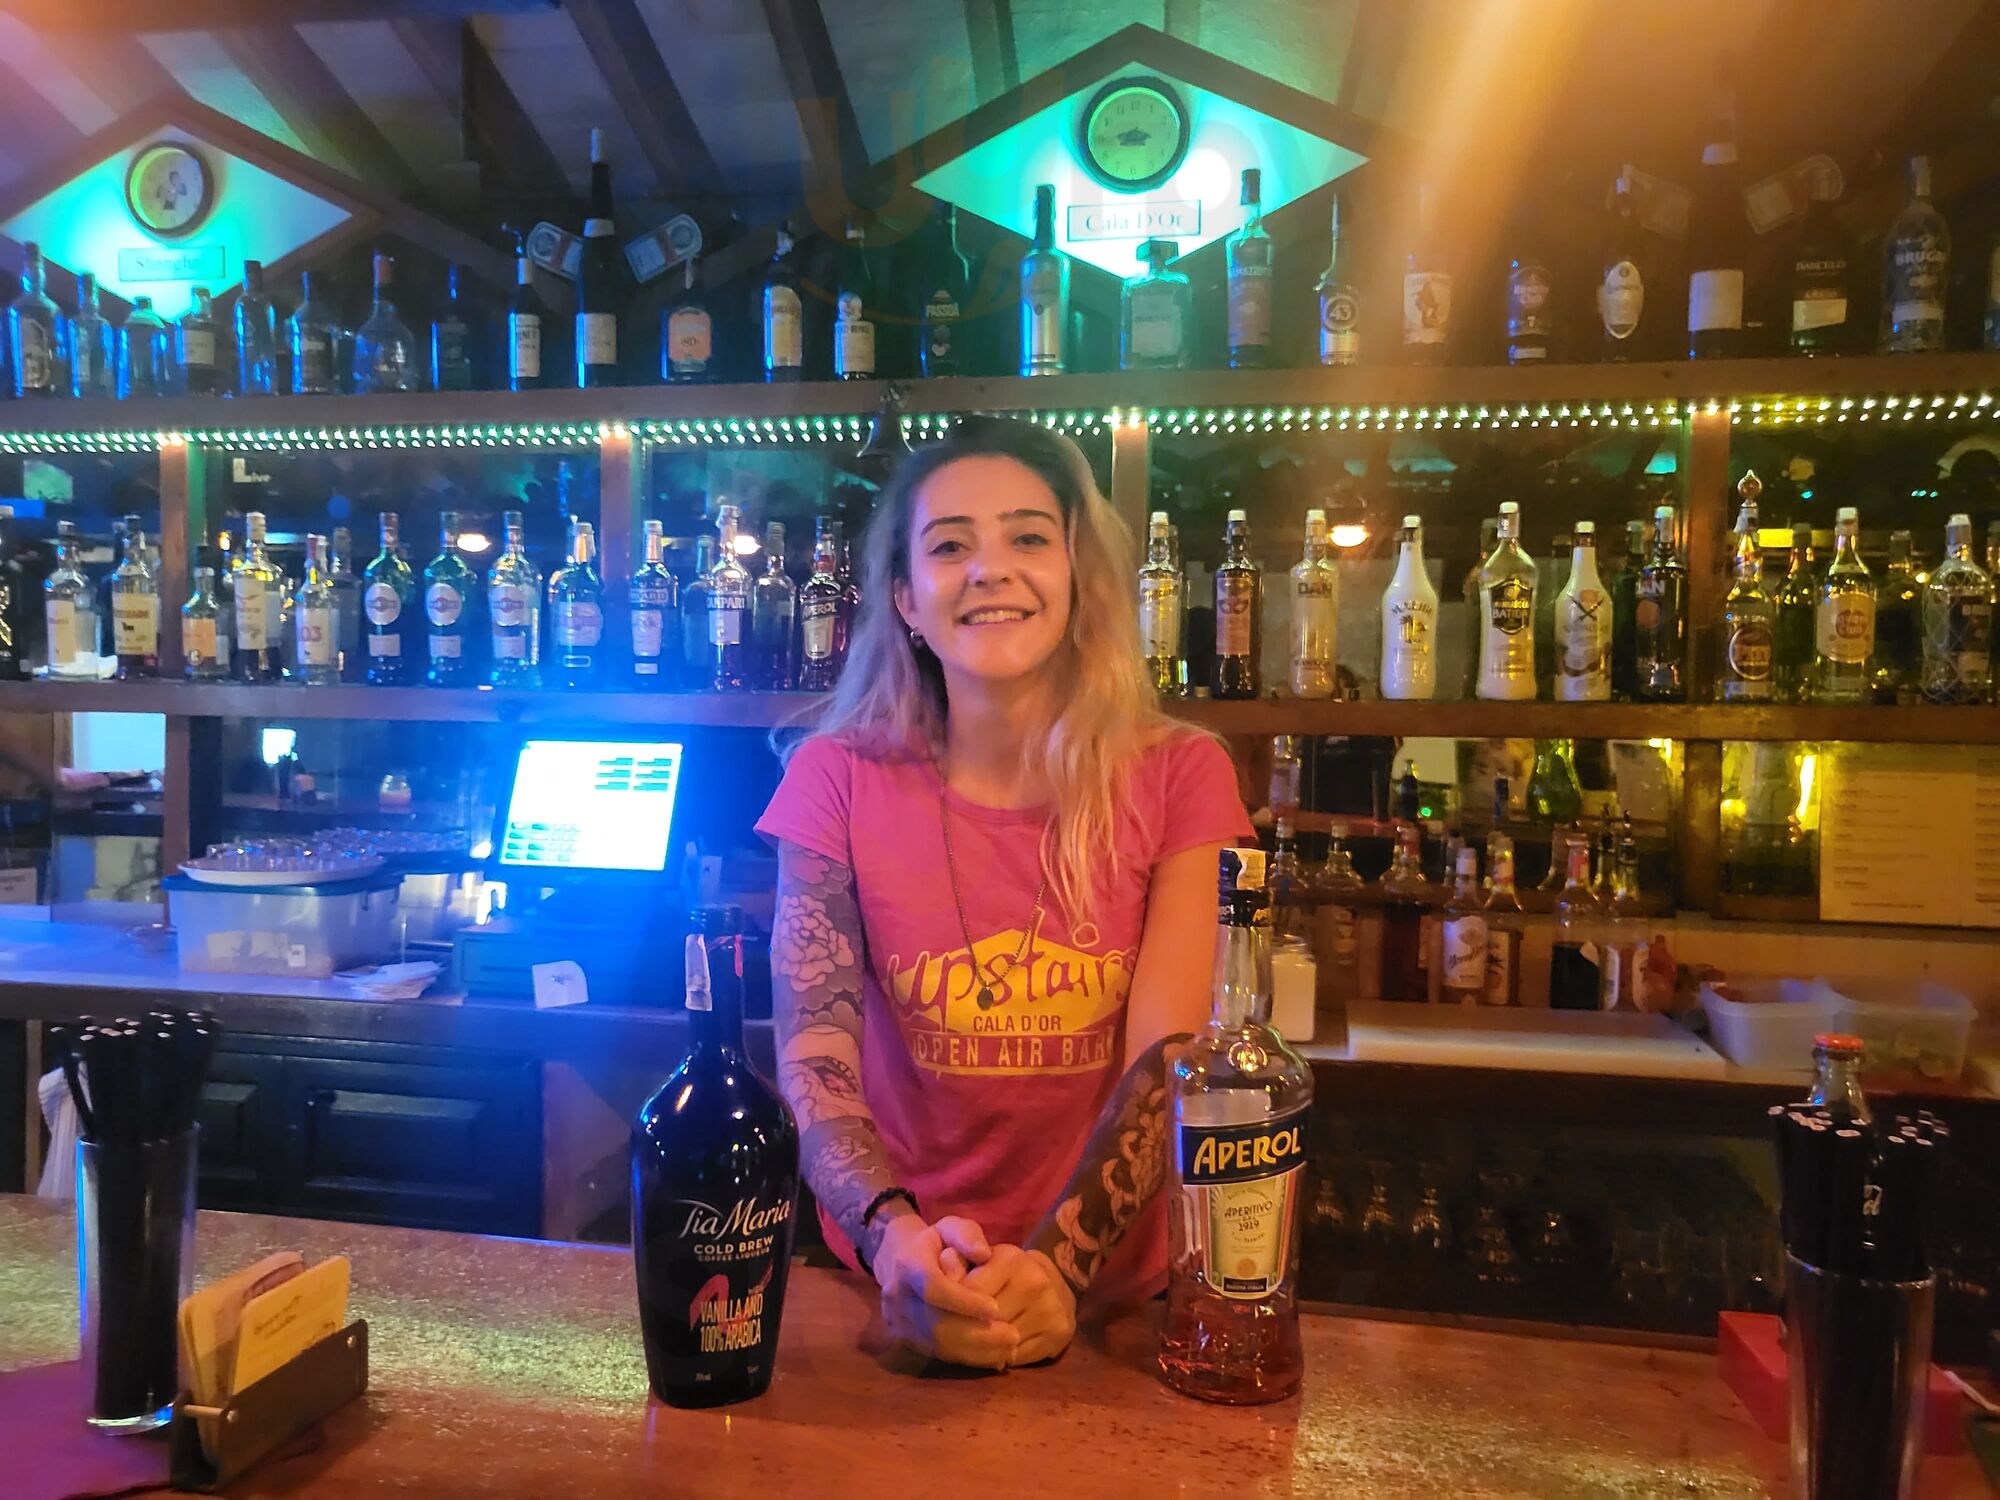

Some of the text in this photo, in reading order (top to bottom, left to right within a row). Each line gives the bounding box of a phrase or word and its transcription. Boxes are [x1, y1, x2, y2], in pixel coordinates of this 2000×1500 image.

[1085, 210, 1182, 232] Cala D'Or
[1329, 304, 1352, 321] 43
[973, 1014, 1062, 1033] CALA D'OR
[919, 1036, 1105, 1067] OPEN AIR BAR
[1193, 1126, 1302, 1176] APEROL
[672, 1196, 791, 1240] Tia Maria
[1223, 1199, 1273, 1217] APERITIVO
[1237, 1219, 1261, 1232] 1919
[693, 1234, 775, 1256] COLD BREW
[697, 1253, 734, 1263] COFFEE
[699, 1293, 764, 1324] VANILLA AND
[699, 1318, 762, 1353] 100% ARABICA
